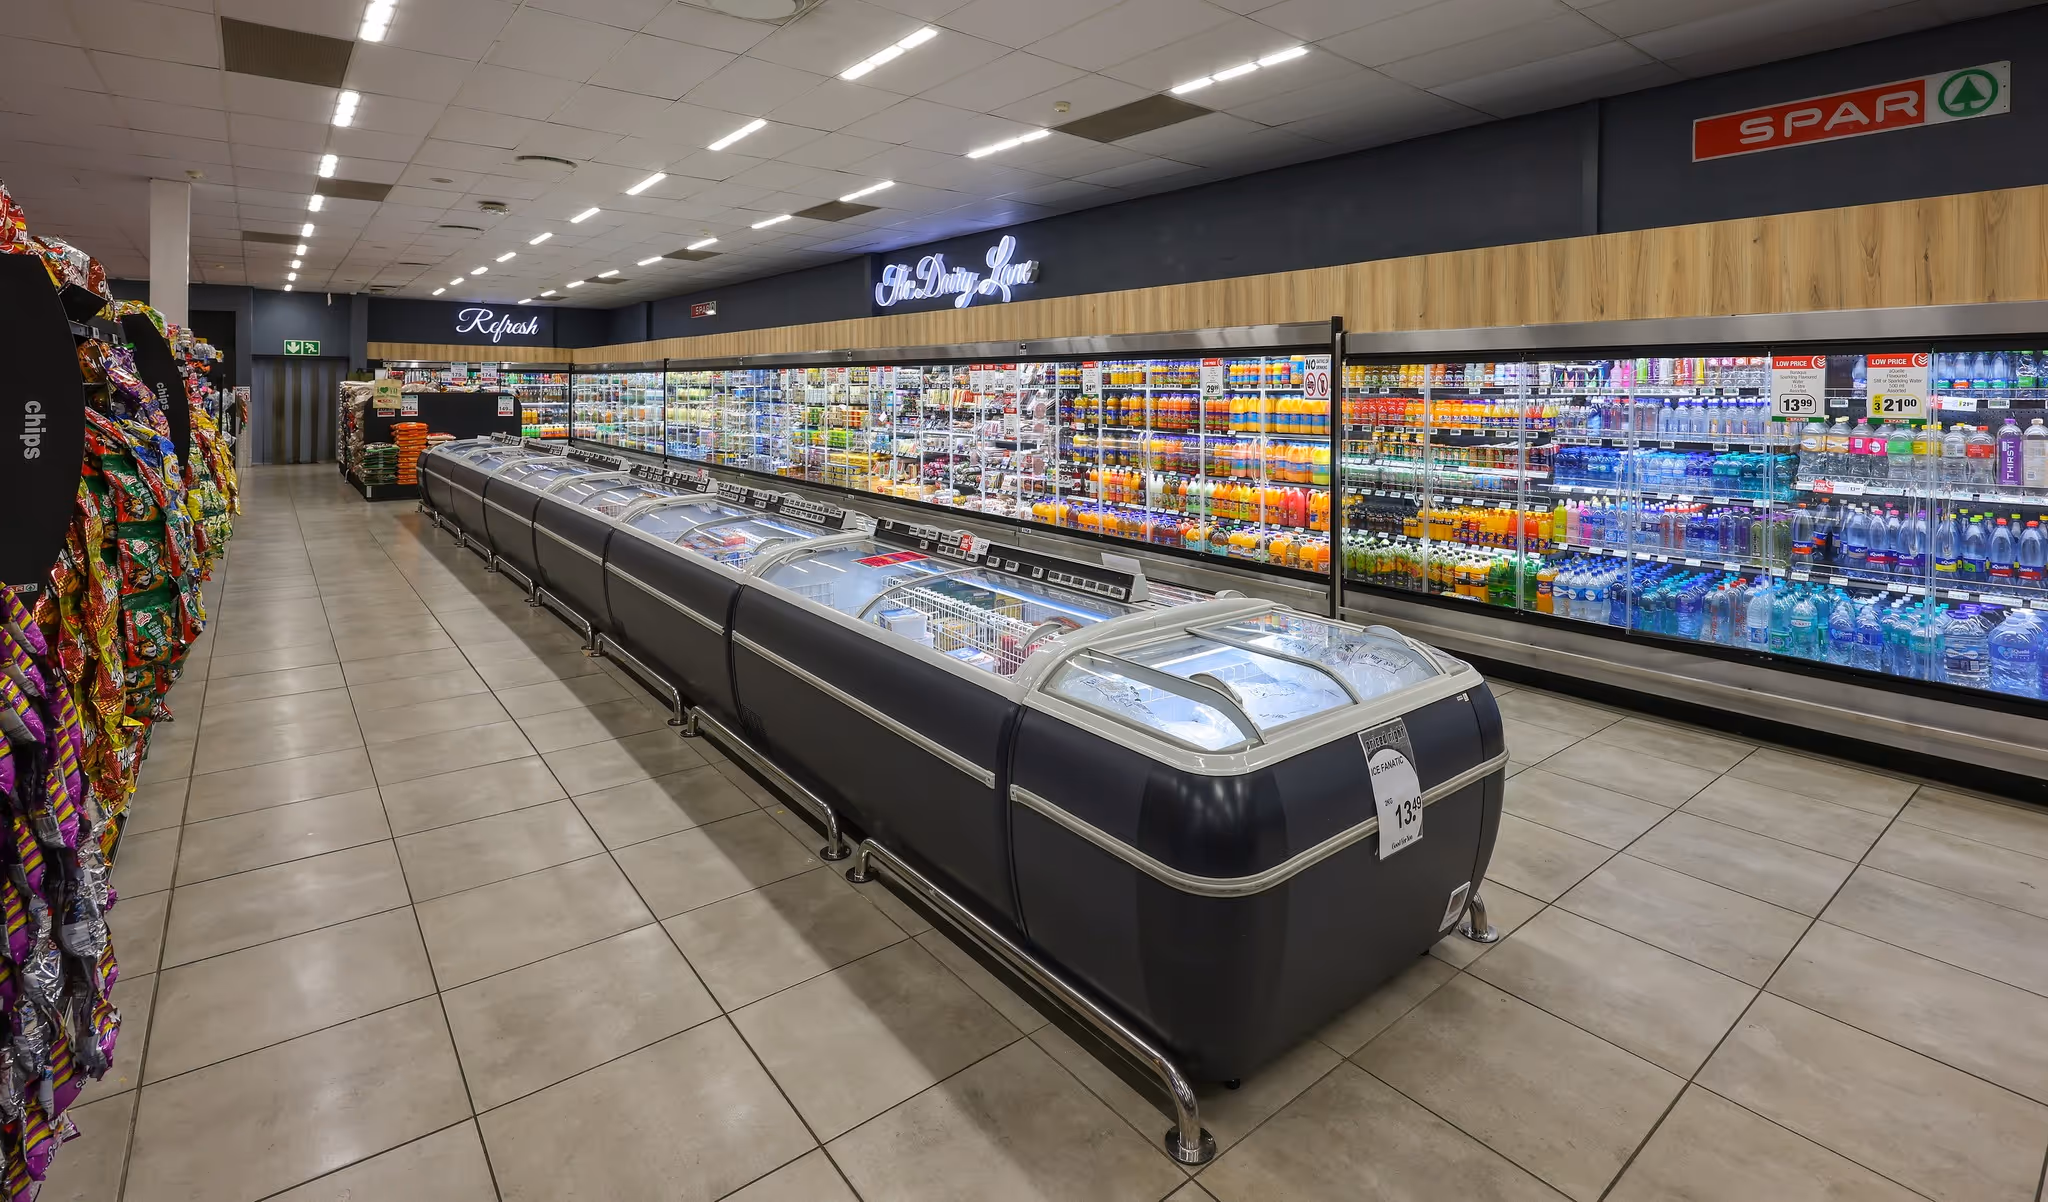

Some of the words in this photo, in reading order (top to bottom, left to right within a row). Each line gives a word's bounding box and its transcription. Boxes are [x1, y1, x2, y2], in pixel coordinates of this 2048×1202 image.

[1739, 89, 1919, 145] SPAR
[875, 263, 916, 307] The
[915, 253, 980, 309] Dairy
[978, 235, 1040, 303] Lane
[456, 308, 540, 344] Refresh
[1306, 359, 1316, 370] NO
[156, 382, 169, 411] chips
[20, 400, 46, 460] chips
[1365, 732, 1387, 753] priced
[1387, 724, 1406, 743] right
[1371, 765, 1380, 776] ICE
[1381, 756, 1404, 771] FANATIC
